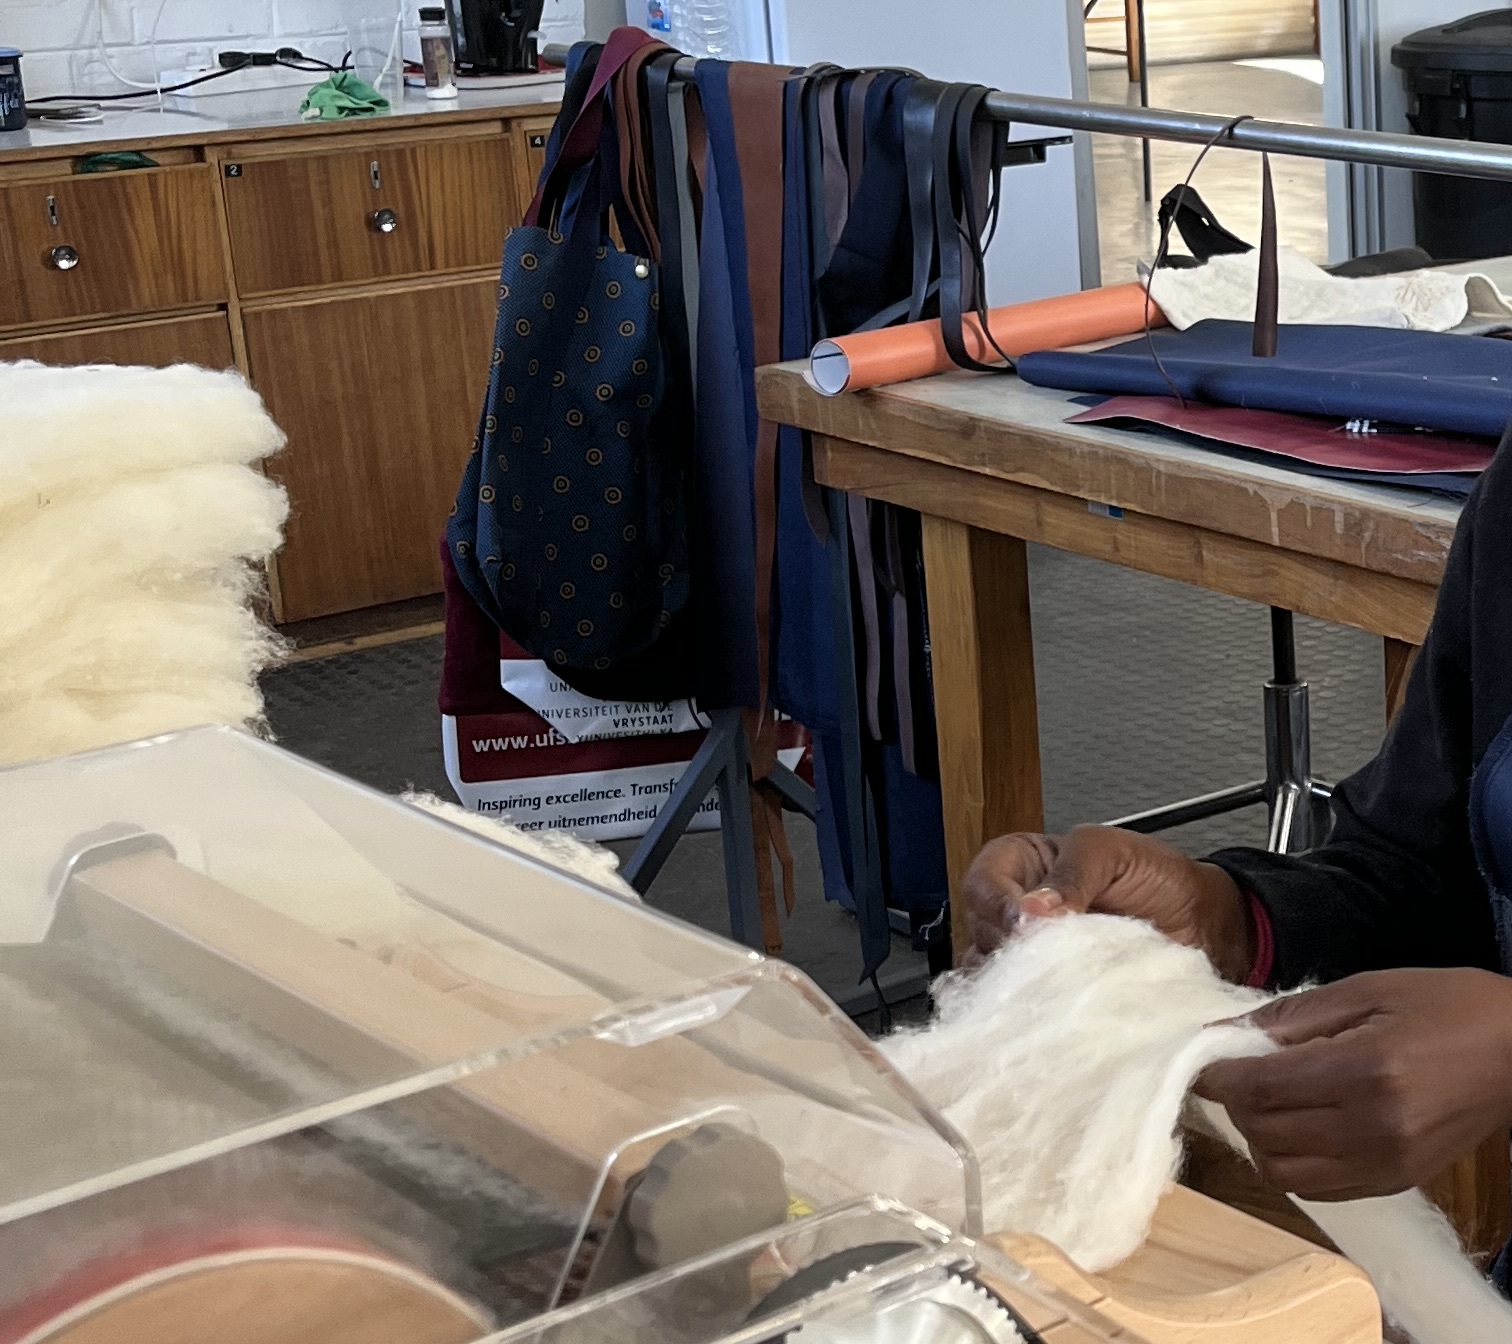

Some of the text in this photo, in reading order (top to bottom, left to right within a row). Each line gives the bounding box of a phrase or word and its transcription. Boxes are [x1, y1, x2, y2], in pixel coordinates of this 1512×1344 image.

[537, 704, 621, 719] NIVERSITEIT
[625, 702, 650, 715] VAN
[612, 714, 674, 729] VRYSTAAT
[477, 777, 679, 813] Inspiring excellence. Transf
[548, 805, 658, 830] uitnemendheid
